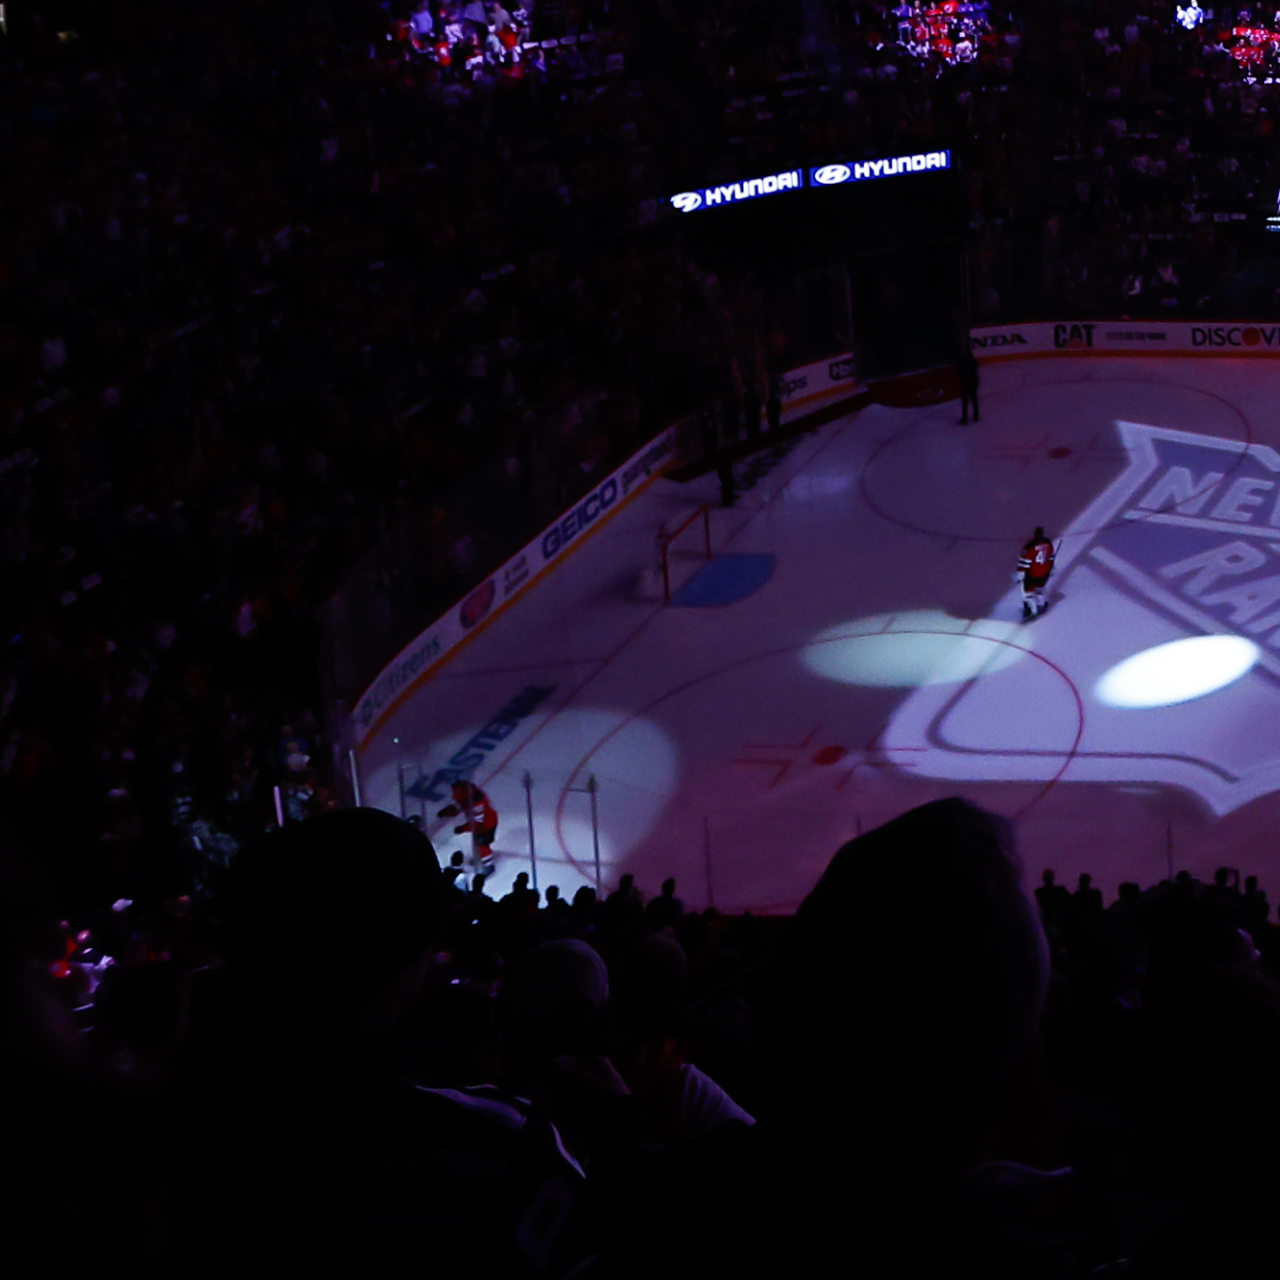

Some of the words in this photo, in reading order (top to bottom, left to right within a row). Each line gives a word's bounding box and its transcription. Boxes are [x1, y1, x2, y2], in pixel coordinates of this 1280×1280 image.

[705, 170, 798, 206] HYUNDAI
[854, 151, 947, 180] HYUNDAI
[1054, 324, 1095, 348] CAT
[541, 477, 618, 560] GEICO
